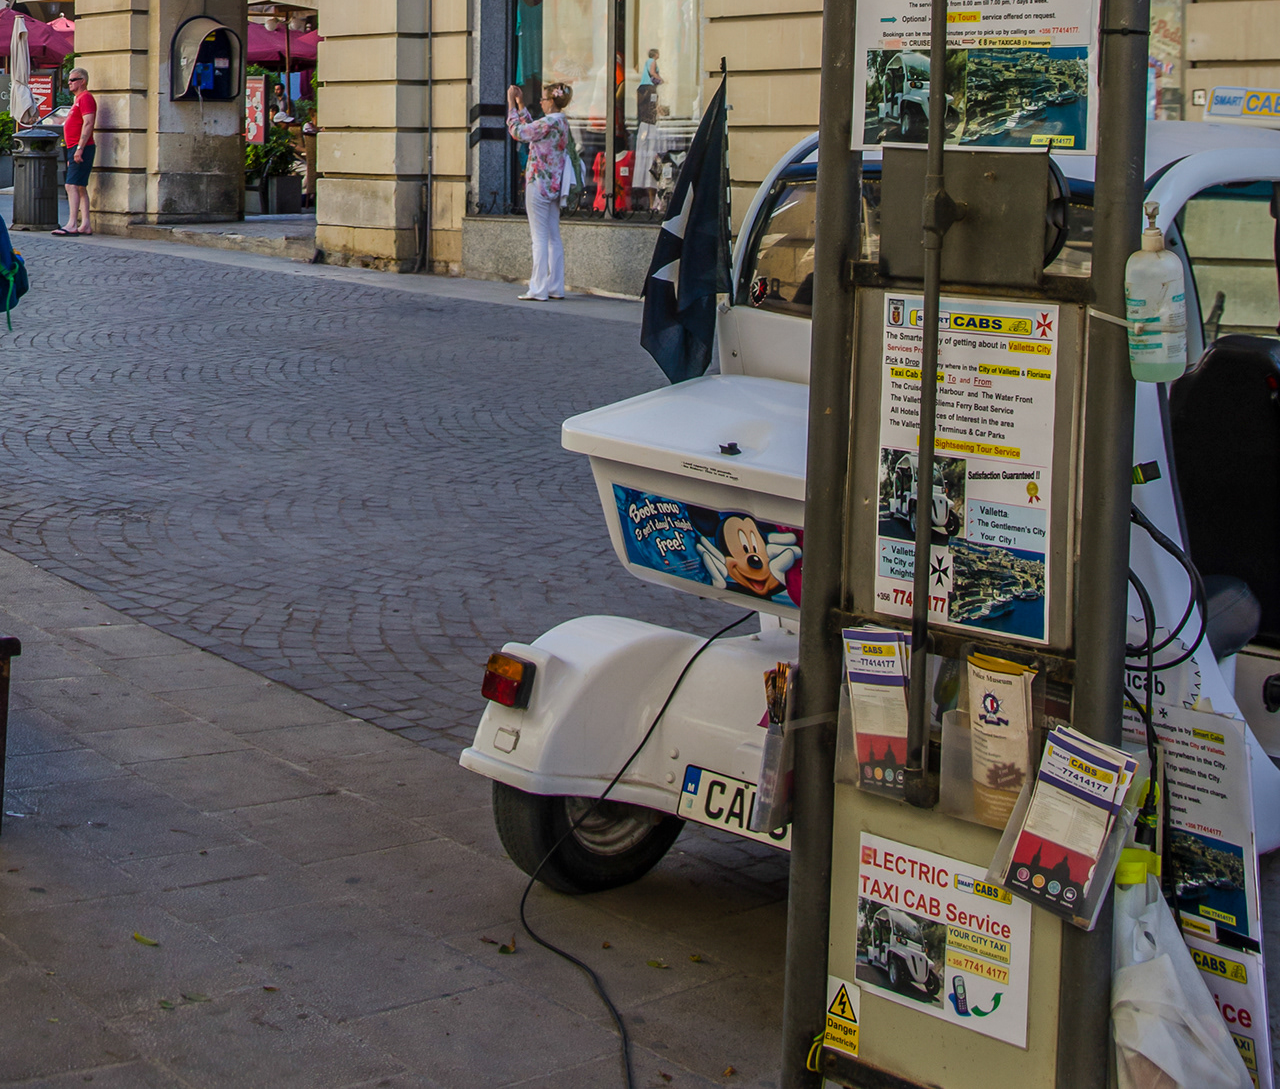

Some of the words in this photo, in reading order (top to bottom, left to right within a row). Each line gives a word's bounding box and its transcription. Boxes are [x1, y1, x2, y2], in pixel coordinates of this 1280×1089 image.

[902, 16, 927, 24] Optional
[984, 28, 994, 36] pick
[1002, 28, 1010, 36] by
[1214, 94, 1244, 106] SMART
[1246, 94, 1280, 114] CAB
[954, 316, 1002, 330] CABS
[886, 331, 898, 340] The
[953, 338, 976, 348] getting
[978, 340, 998, 349] about
[1000, 342, 1006, 350] in
[1008, 342, 1034, 352] Valletta
[887, 344, 912, 353] Services
[885, 356, 898, 365] Pick
[905, 358, 920, 367] Drop
[978, 366, 990, 374] City
[998, 368, 1020, 376] Valletta
[1026, 370, 1051, 380] Floriana
[890, 368, 904, 376] Taxi
[906, 370, 918, 378] Cab
[948, 374, 956, 384] To
[960, 376, 970, 384] and
[973, 376, 992, 388] From
[891, 381, 902, 389] The
[940, 386, 964, 396] Harbour
[982, 391, 994, 400] The
[994, 392, 1014, 402] Water
[1015, 395, 1034, 404] Front
[890, 394, 902, 402] The
[956, 401, 972, 412] Ferry
[974, 403, 989, 412] Boat
[990, 405, 1014, 414] Service
[890, 406, 899, 414] All
[900, 407, 919, 416] Hotels
[956, 414, 980, 424] Interest
[988, 418, 999, 426] the
[1000, 420, 1014, 428] area
[890, 418, 900, 426] The
[938, 424, 967, 435] Terminus
[974, 429, 986, 437] Car
[988, 430, 1006, 440] Parks
[935, 438, 974, 454] Sightseeing
[976, 444, 992, 454] Tour
[994, 447, 1020, 458] Service
[1002, 470, 1034, 480] Guaranteed
[629, 498, 658, 524] Book
[656, 502, 680, 514] now
[978, 518, 990, 528] The
[990, 520, 1031, 534] Gentlemen's
[1032, 527, 1046, 538] City
[656, 530, 686, 556] free!
[980, 532, 996, 542] Your
[998, 536, 1012, 546] City
[882, 556, 892, 564] The
[894, 557, 906, 568] City
[908, 560, 914, 568] of
[862, 645, 883, 655] CABS
[860, 658, 896, 668] 77414177
[985, 672, 1013, 686] Museum
[1124, 674, 1166, 696] icab
[1072, 758, 1098, 776] CABS
[1062, 767, 1109, 792] 77414177
[861, 844, 949, 888] ELECTRIC
[957, 879, 974, 889] SMART
[975, 882, 999, 898] CABS
[860, 874, 899, 904] TAXI
[903, 889, 941, 918] CAB
[946, 903, 1012, 939] Service
[948, 928, 970, 941] YOUR
[972, 935, 988, 946] CITY
[990, 941, 1007, 952] TAXI
[948, 940, 978, 953] SATISFACTION
[979, 949, 1008, 963] GUARANTEED
[964, 958, 984, 974] 7741
[986, 964, 1008, 980] 4177
[1192, 952, 1227, 974] CABS
[828, 1018, 857, 1036] Danger
[825, 1032, 857, 1050] Electricity
